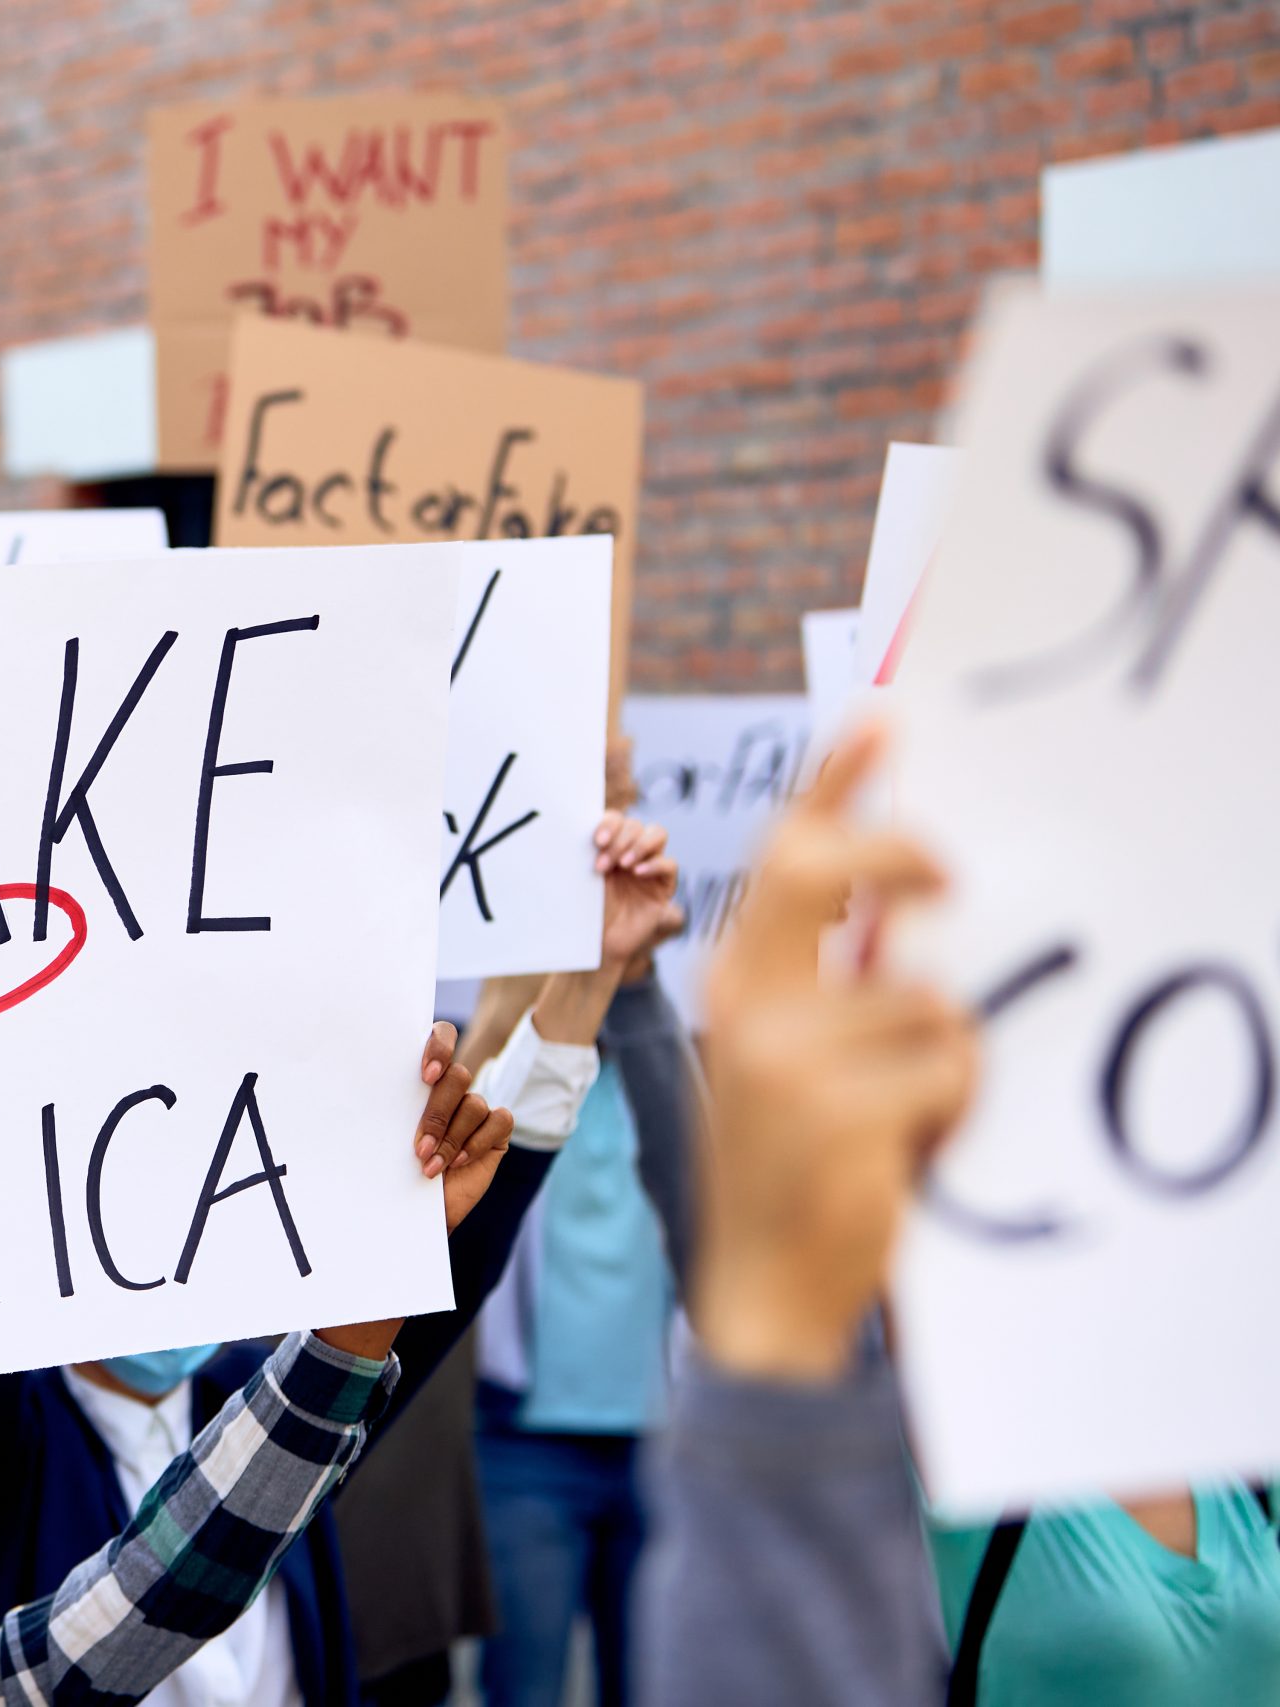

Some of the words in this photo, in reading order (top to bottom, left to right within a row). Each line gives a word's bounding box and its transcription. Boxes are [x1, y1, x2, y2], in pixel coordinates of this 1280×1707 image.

[180, 113, 234, 230] I
[266, 116, 498, 212] WANT
[261, 212, 358, 273] MY
[232, 387, 397, 535] Fact
